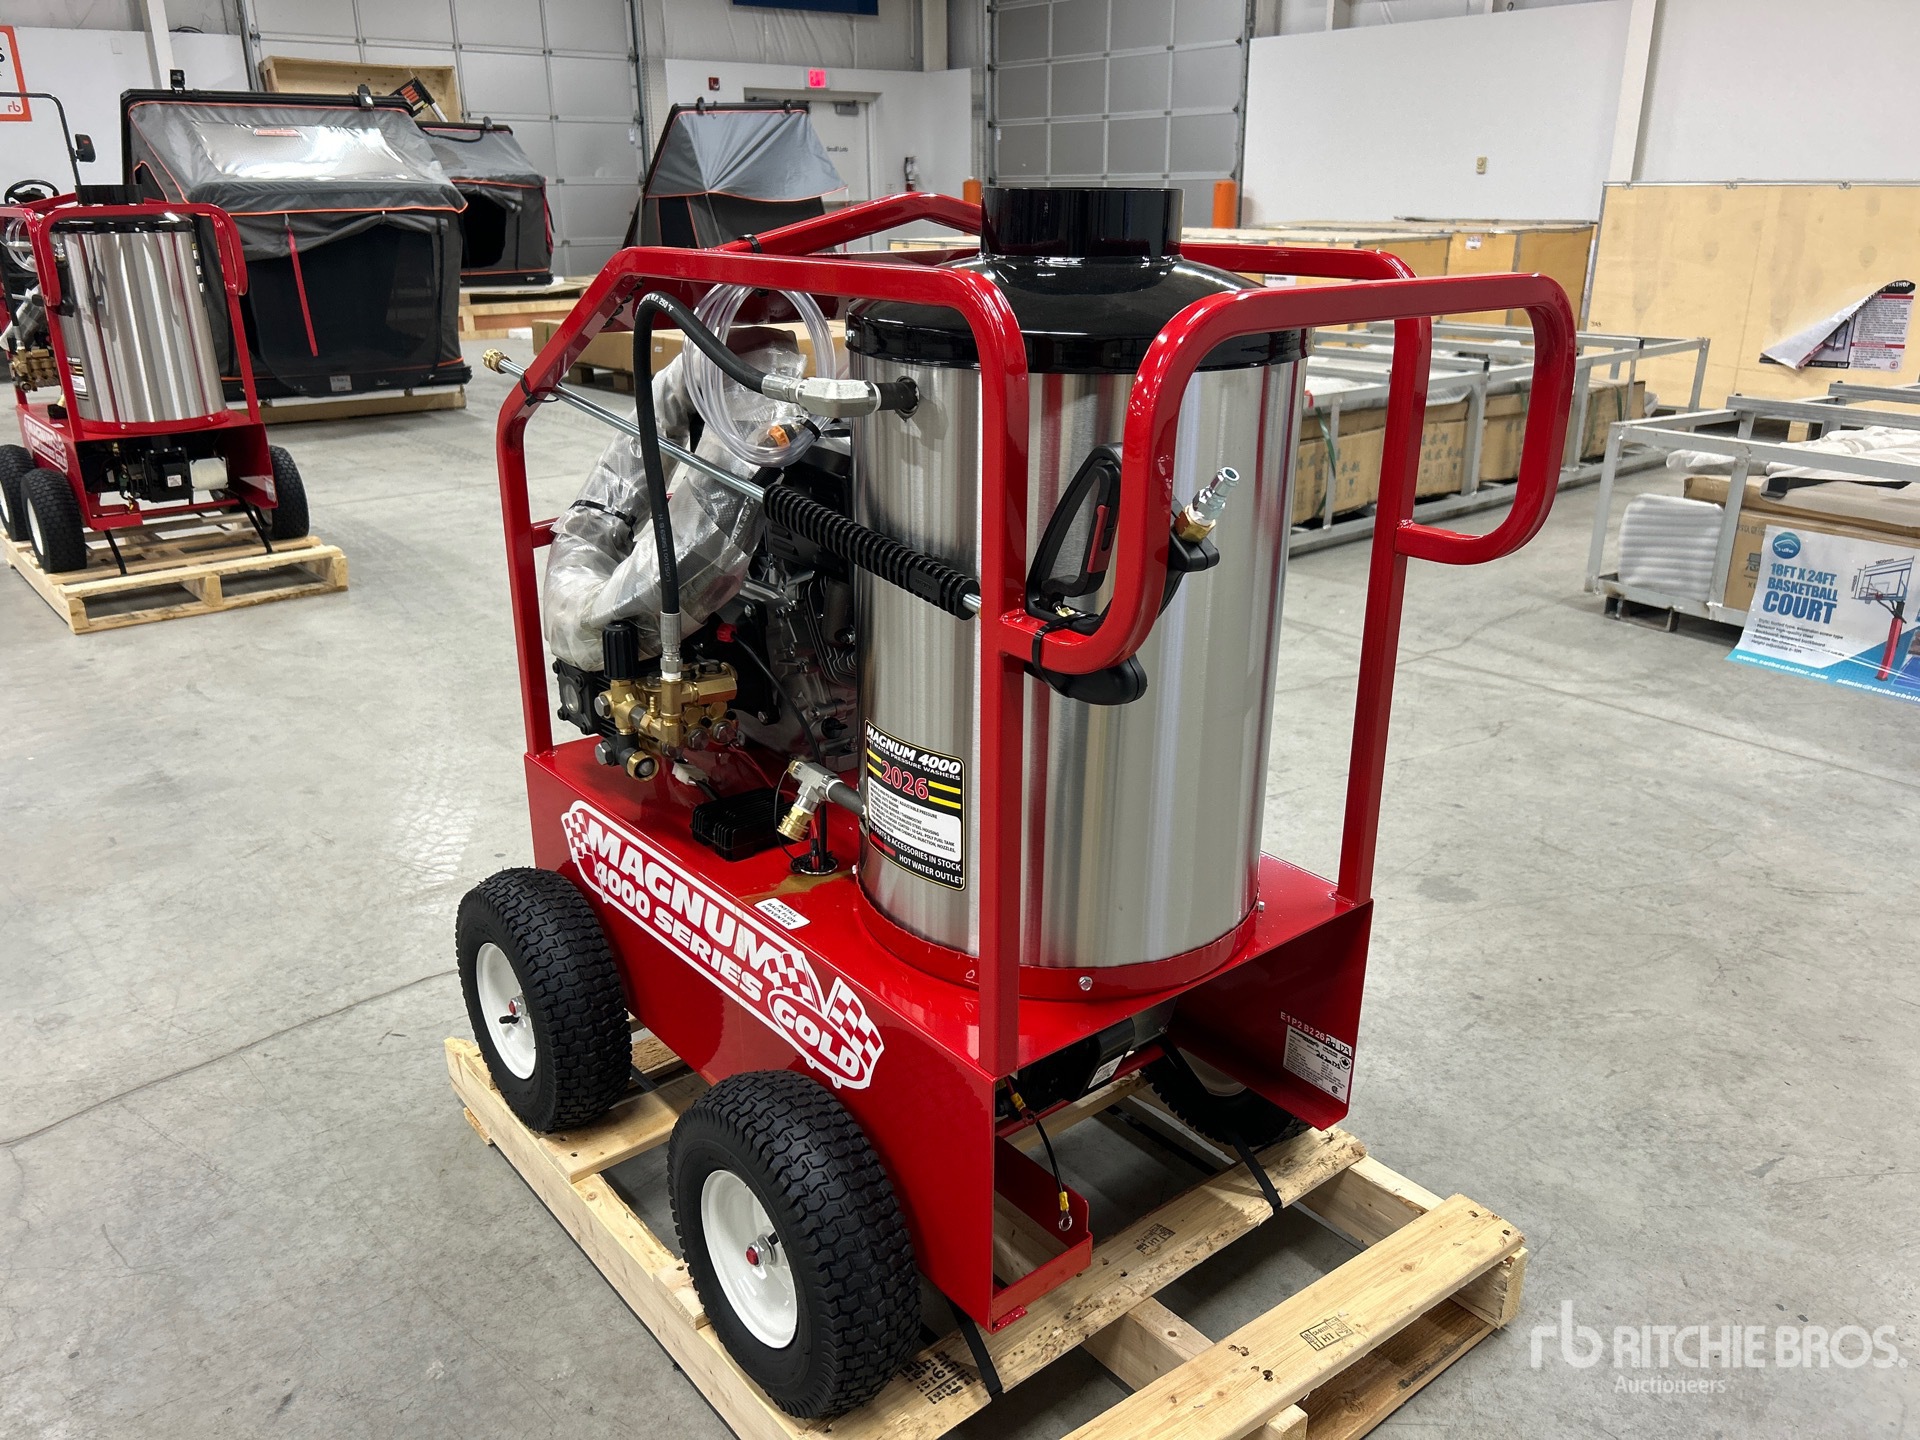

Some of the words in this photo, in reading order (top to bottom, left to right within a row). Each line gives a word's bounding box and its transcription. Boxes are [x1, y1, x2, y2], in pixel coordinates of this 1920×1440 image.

[1767, 577, 1838, 602] BASKETBALL
[1770, 562, 1795, 578] 18FT
[1797, 568, 1806, 580] X
[1806, 570, 1838, 586] 24FT
[1762, 591, 1838, 624] COURT
[866, 724, 916, 762] MAGNUM
[918, 754, 961, 774] 4000
[881, 760, 929, 800] 2026
[890, 752, 922, 770] PRESSURE
[922, 766, 960, 781] WASHERS
[892, 838, 928, 861] ACCESSORIES
[928, 854, 936, 864] IN
[937, 858, 961, 872] STOCK
[900, 854, 912, 865] HOT
[912, 860, 934, 876] WATER
[934, 870, 964, 886] OUTLET
[587, 818, 776, 979] MAGNUM
[594, 861, 651, 918] 4000
[654, 907, 763, 1001] SERIES
[772, 998, 861, 1077] GOLD
